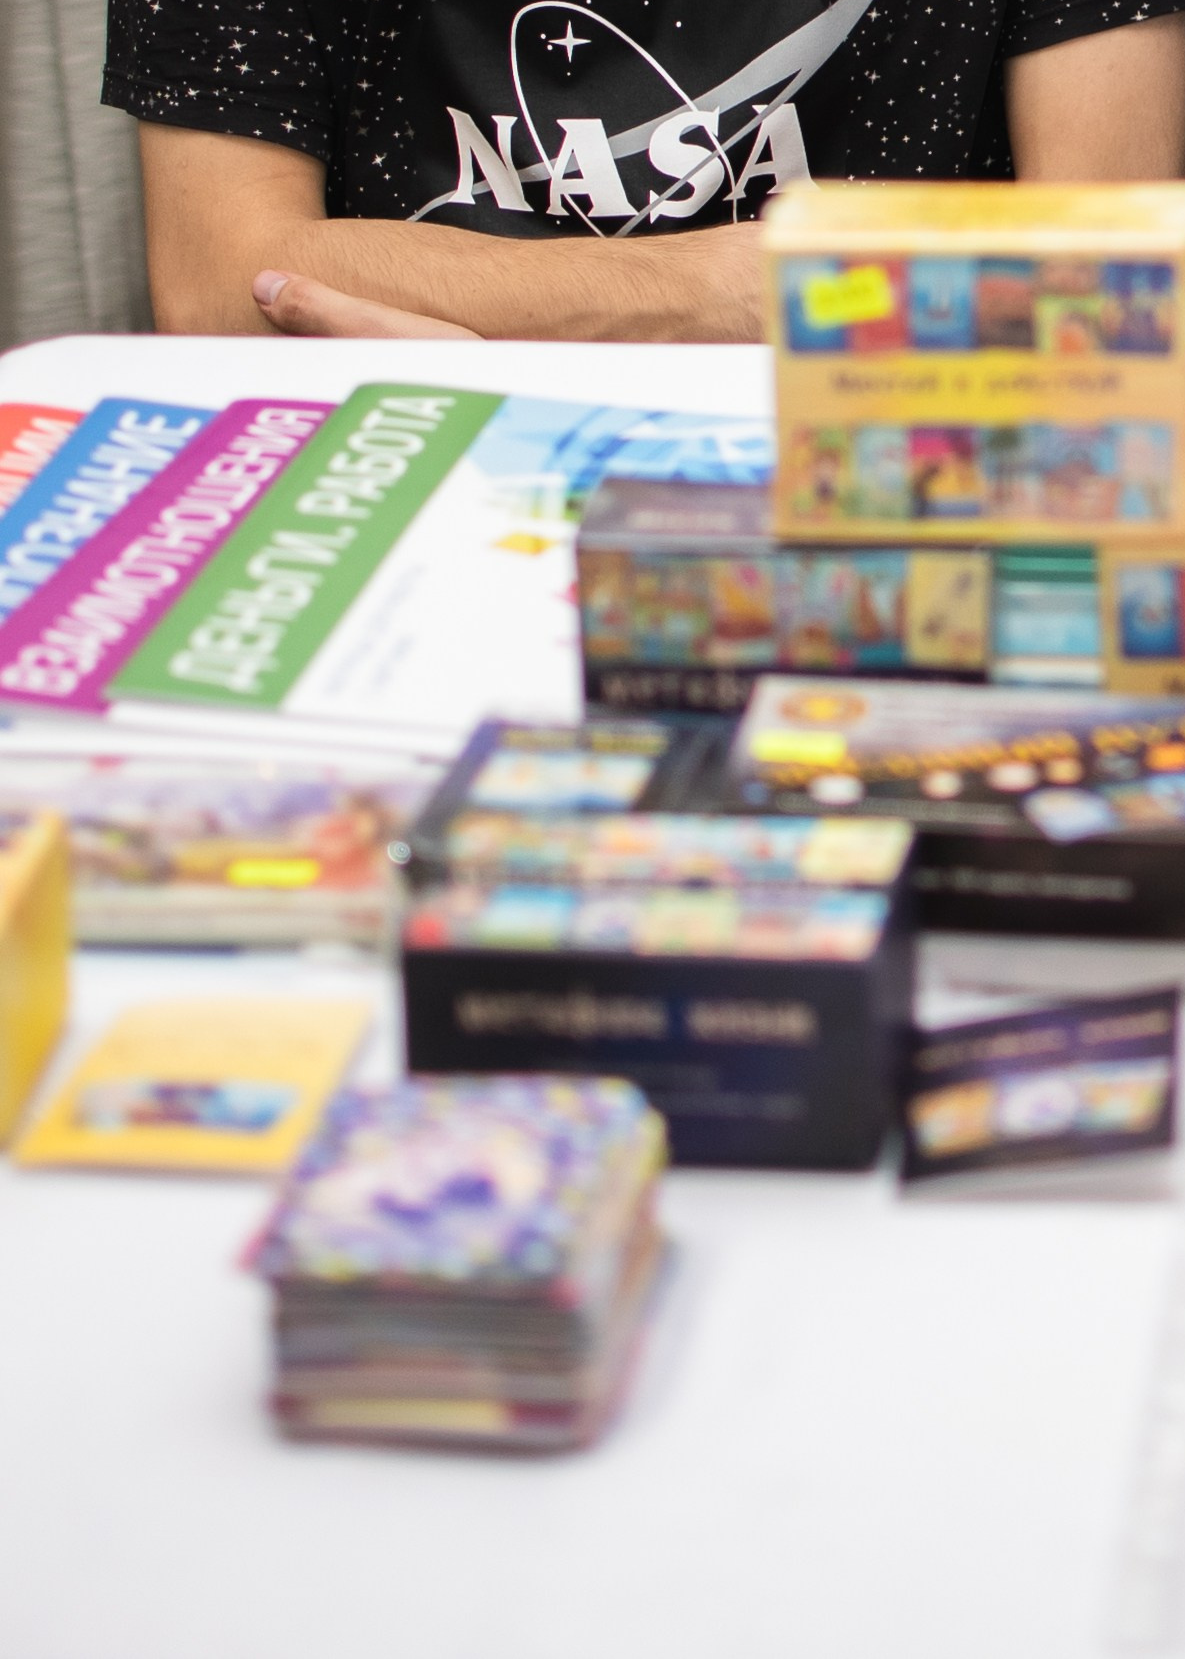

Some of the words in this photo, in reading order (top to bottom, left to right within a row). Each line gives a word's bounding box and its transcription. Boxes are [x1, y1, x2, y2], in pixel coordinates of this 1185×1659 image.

[446, 104, 823, 224] NASA
[169, 525, 357, 693] ДЕНЬГИ.
[297, 395, 457, 519] РАБОТА
